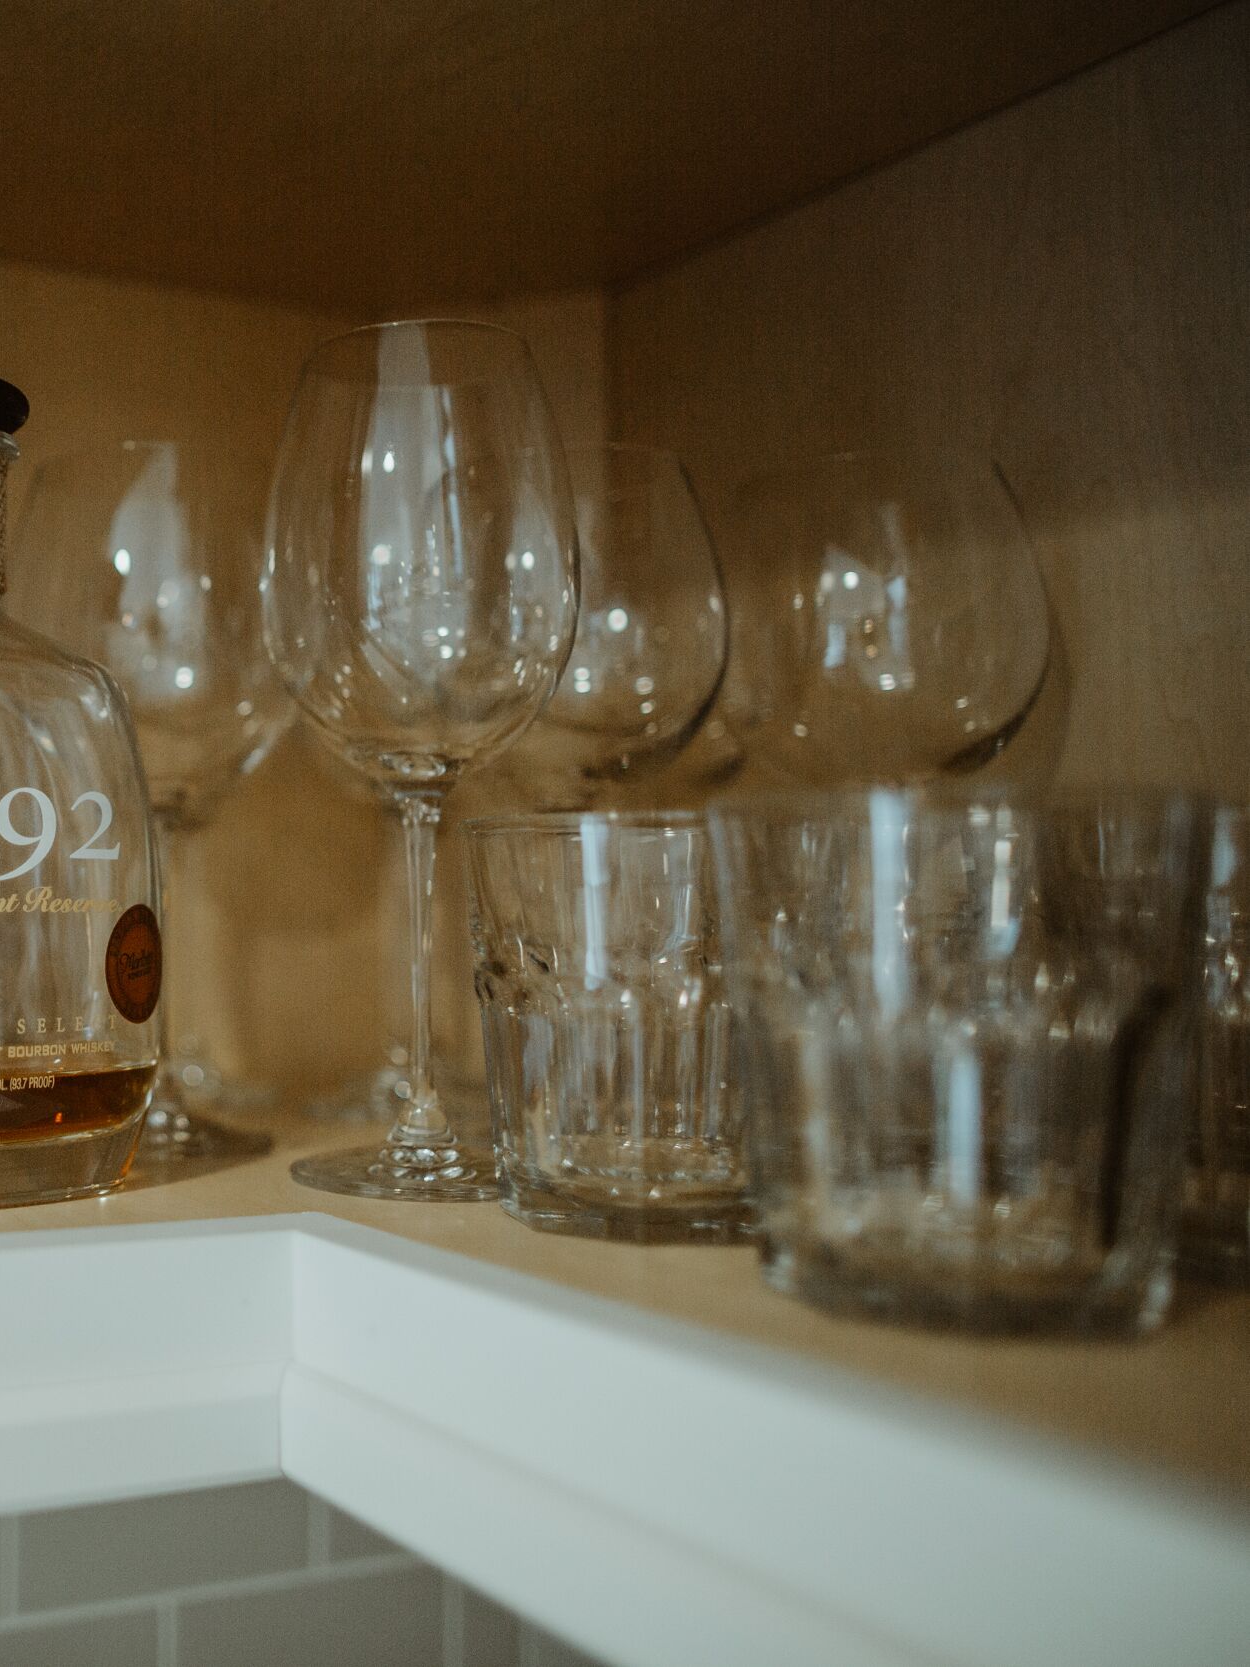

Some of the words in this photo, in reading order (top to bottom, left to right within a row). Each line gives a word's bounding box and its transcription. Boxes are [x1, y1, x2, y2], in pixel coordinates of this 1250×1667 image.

[23, 886, 119, 912] Reserve
[8, 1043, 67, 1058] BOURBON
[71, 1039, 116, 1055] WHISKEY
[9, 1076, 28, 1092] (93.7
[28, 1074, 56, 1090] PROOF)
